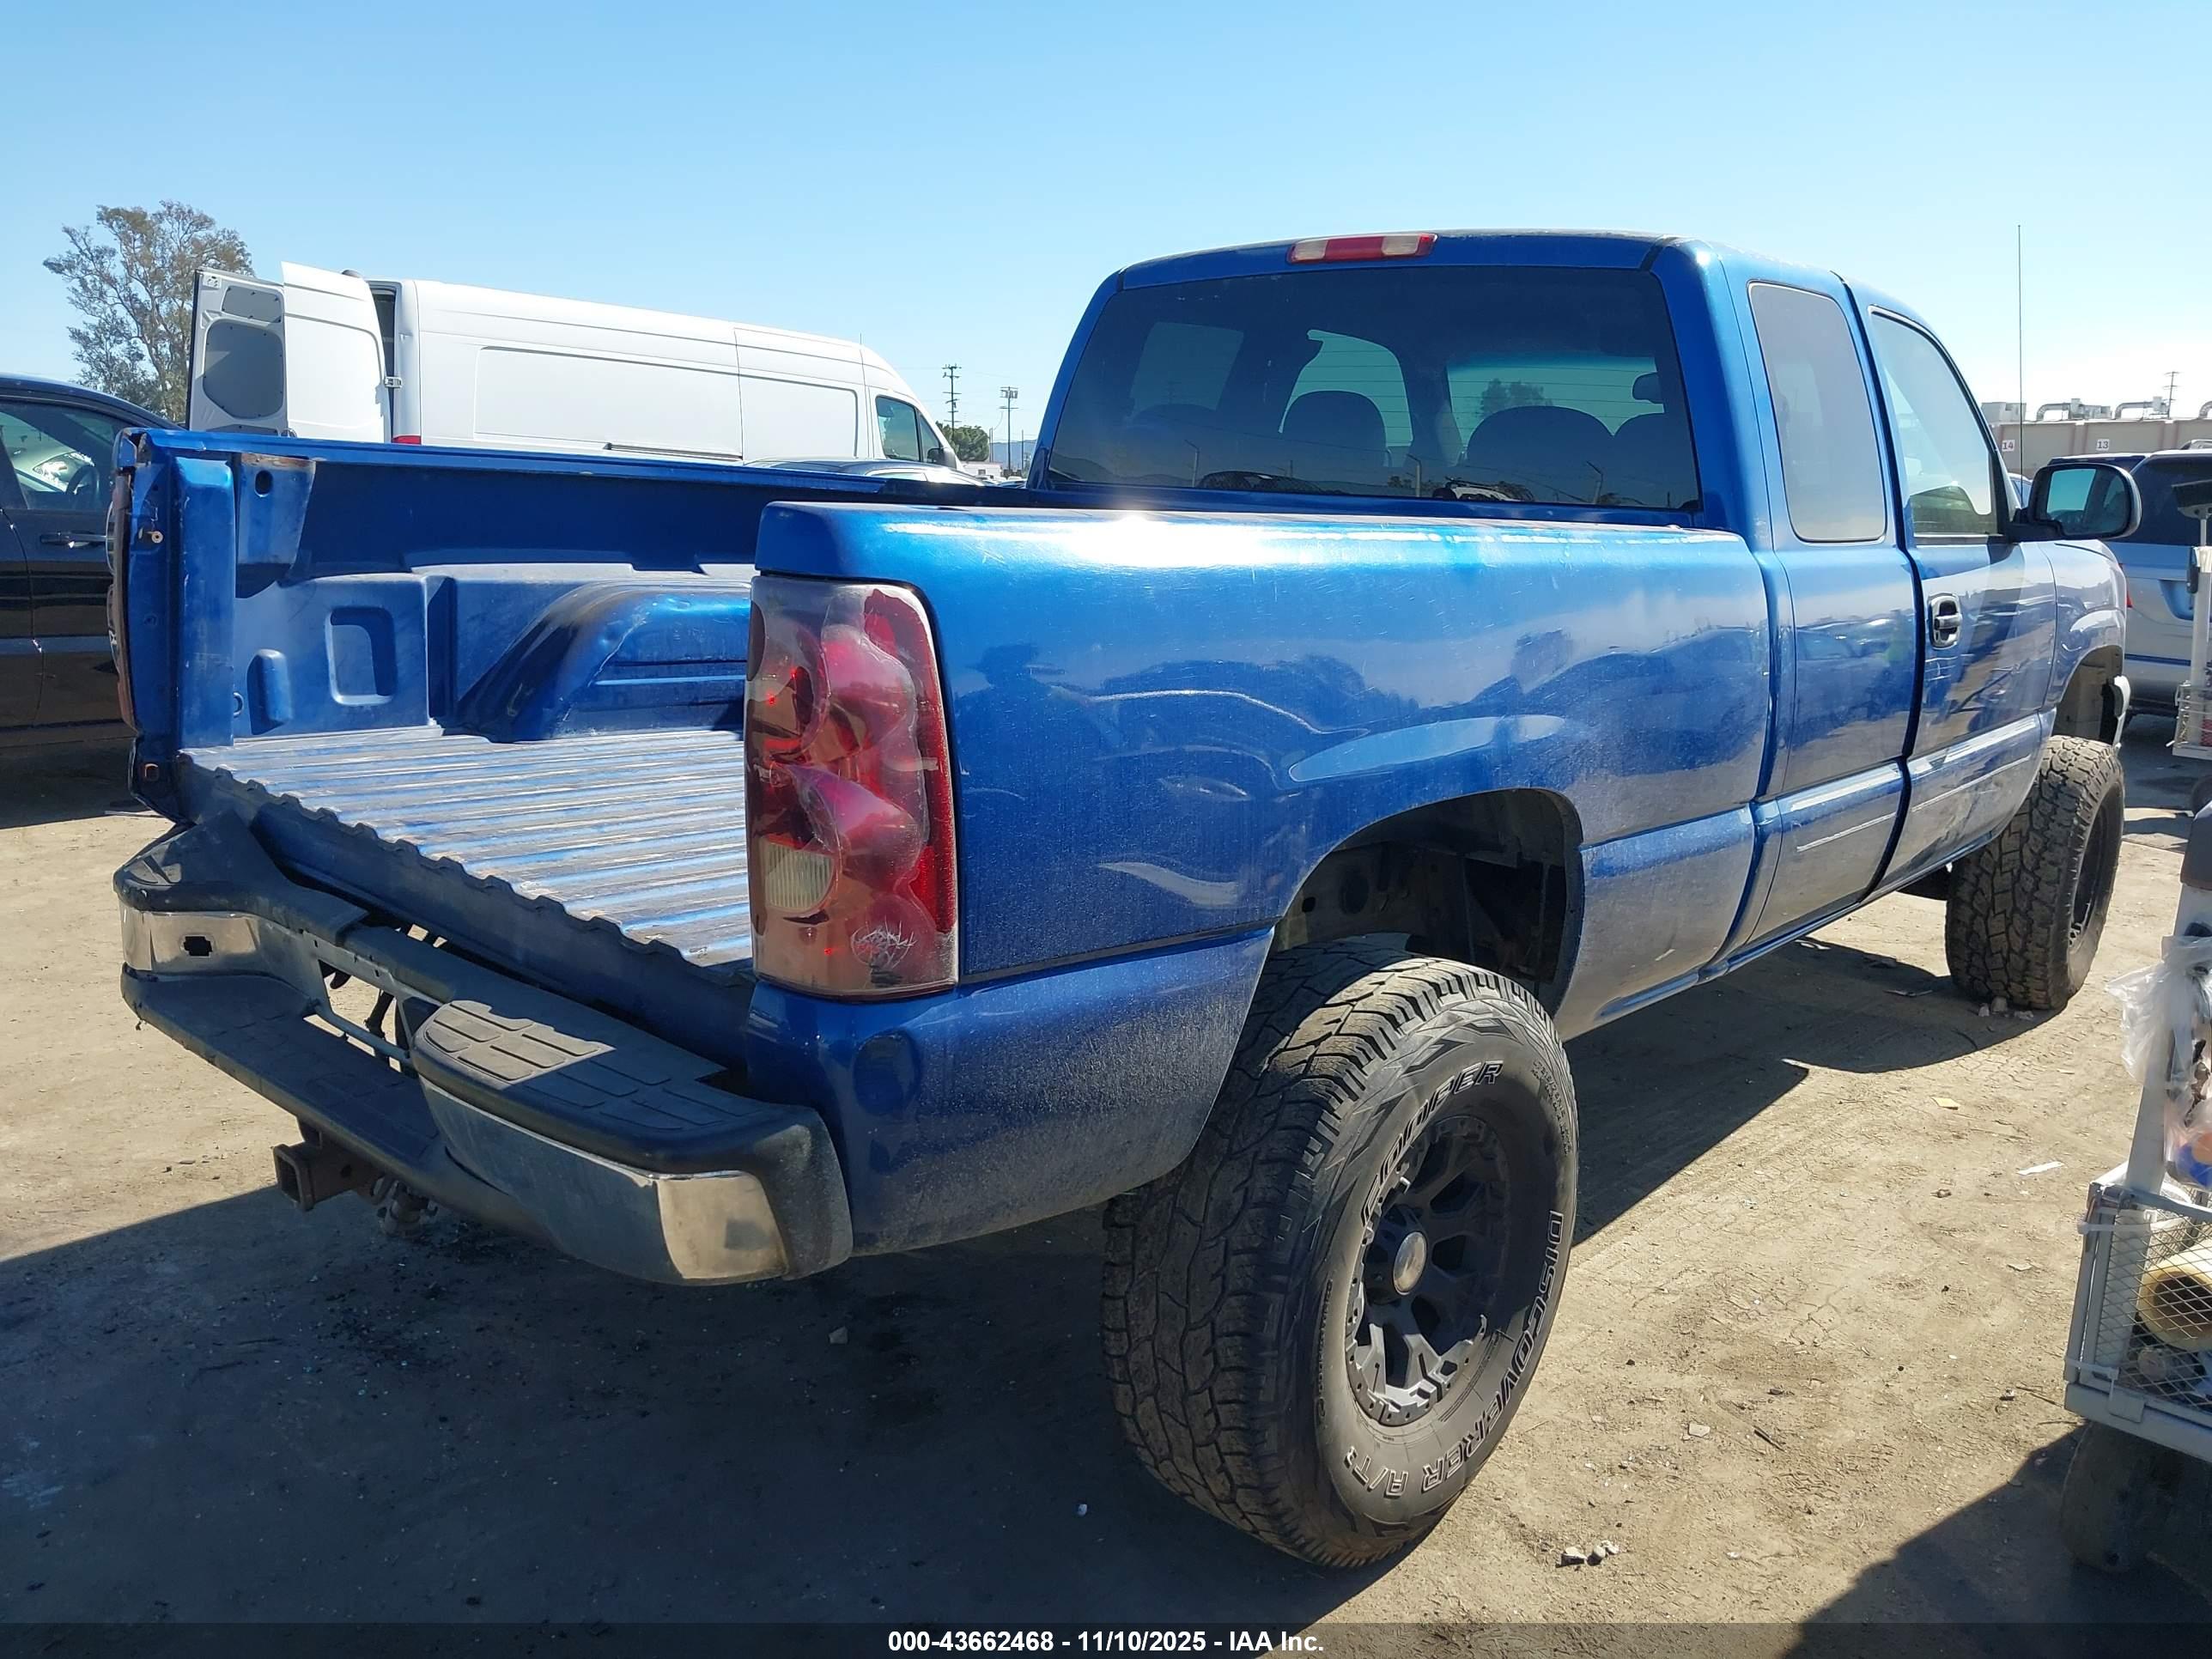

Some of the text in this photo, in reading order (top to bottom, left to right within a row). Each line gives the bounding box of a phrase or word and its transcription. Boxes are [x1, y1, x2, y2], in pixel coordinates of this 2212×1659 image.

[2002, 441, 2014, 450] 14
[2098, 441, 2109, 449] 13
[1361, 1060, 1504, 1226] COOPER
[1421, 1210, 1564, 1494] DISCOVERER
